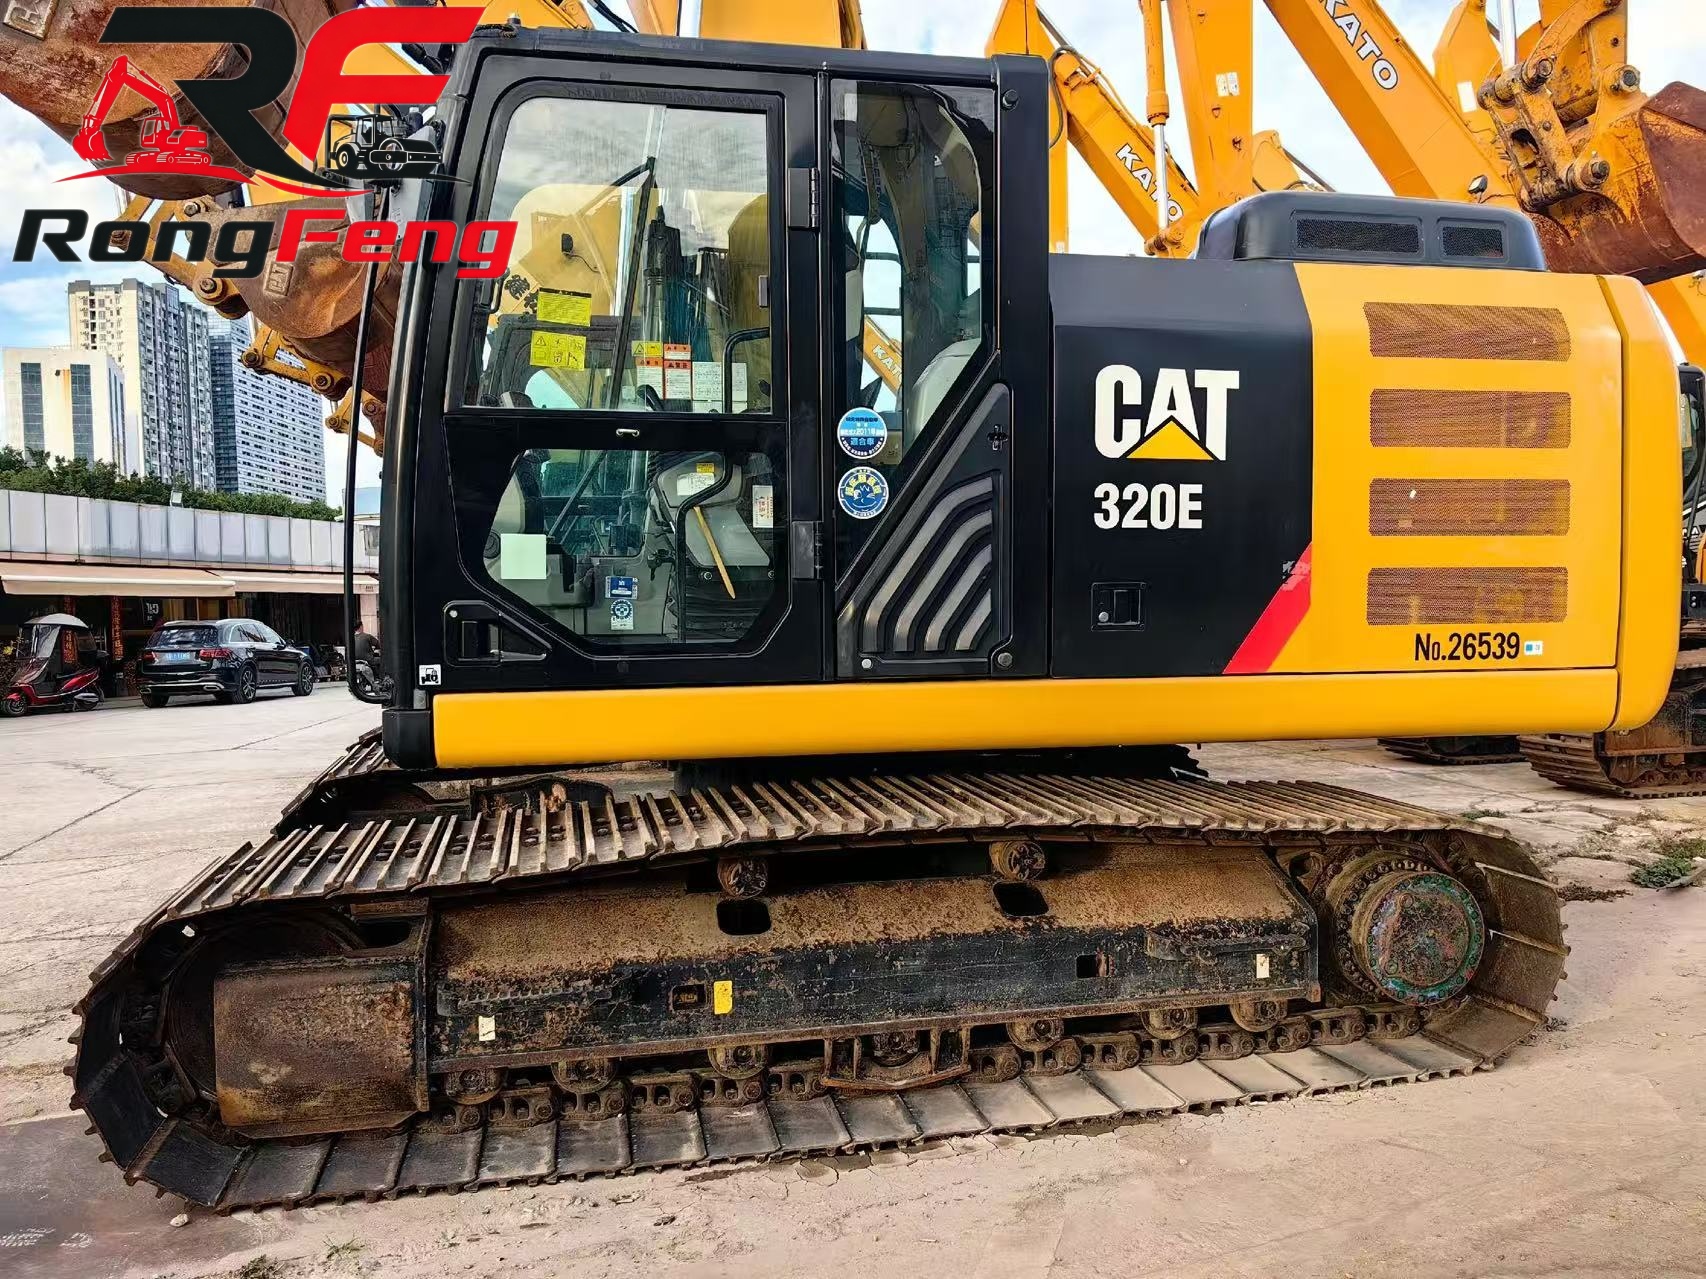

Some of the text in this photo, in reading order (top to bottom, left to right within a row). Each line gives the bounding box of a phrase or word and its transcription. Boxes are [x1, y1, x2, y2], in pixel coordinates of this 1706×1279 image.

[1094, 364, 1241, 461] CAT
[1093, 482, 1204, 530] 320E
[1414, 631, 1520, 661] No.26539
